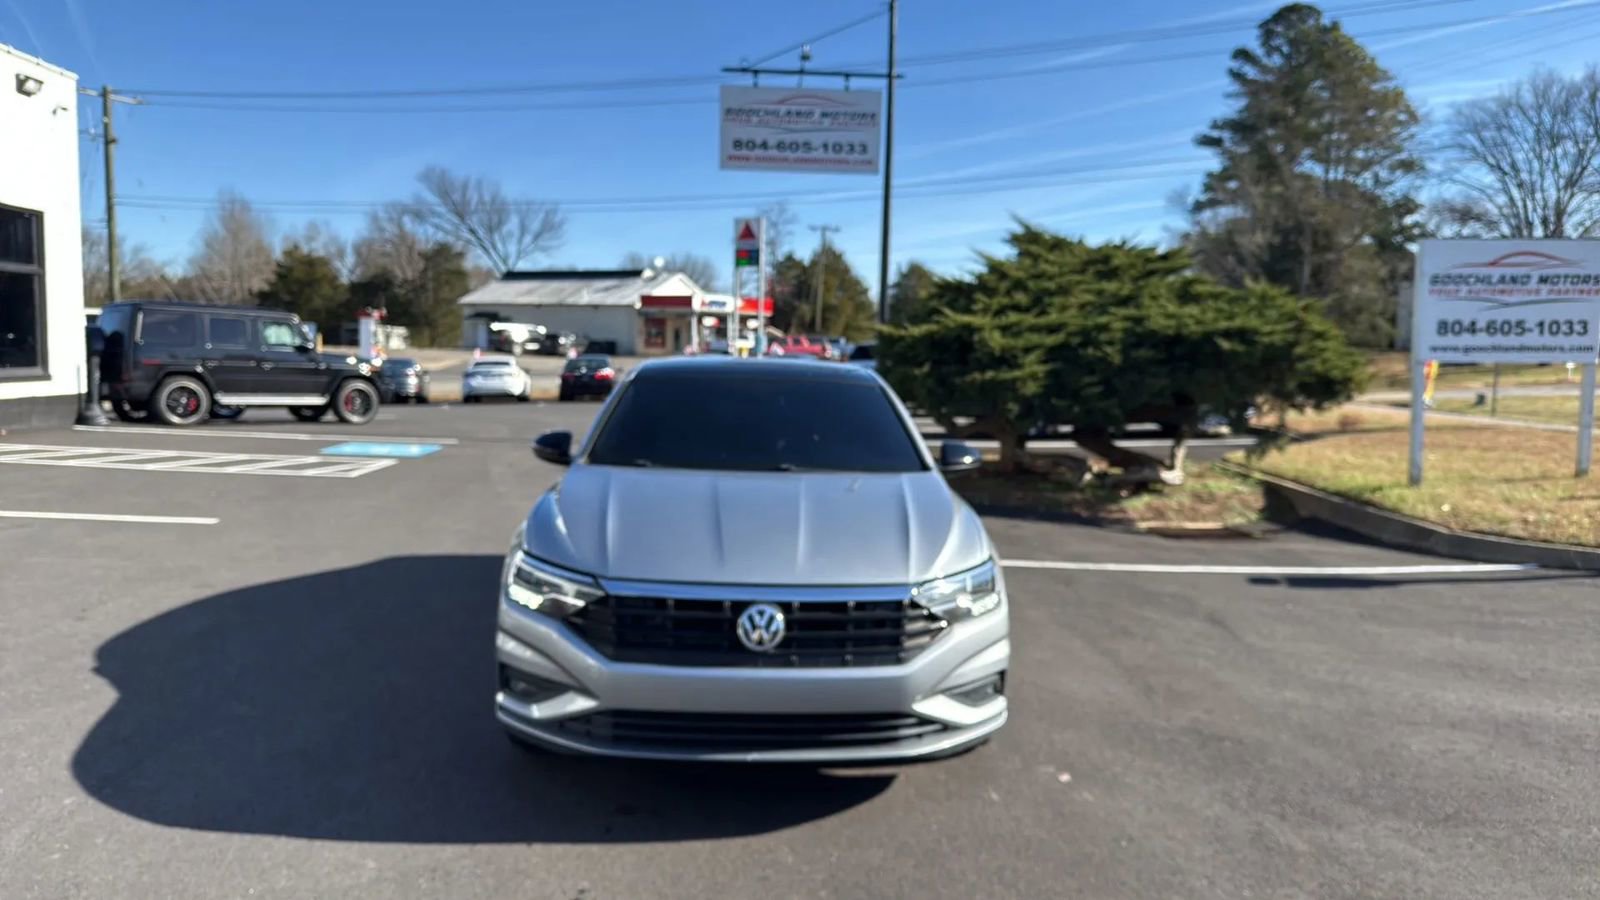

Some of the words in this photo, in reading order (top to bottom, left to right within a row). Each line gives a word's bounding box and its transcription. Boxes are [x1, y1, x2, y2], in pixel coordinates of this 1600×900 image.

[732, 138, 869, 156] 804-605-1033
[1429, 273, 1531, 287] GOOCHLAND
[1537, 273, 1600, 287] MOTORS
[1436, 319, 1589, 337] 804-605-1033
[1429, 343, 1594, 355] www.goochlandmotors.com
